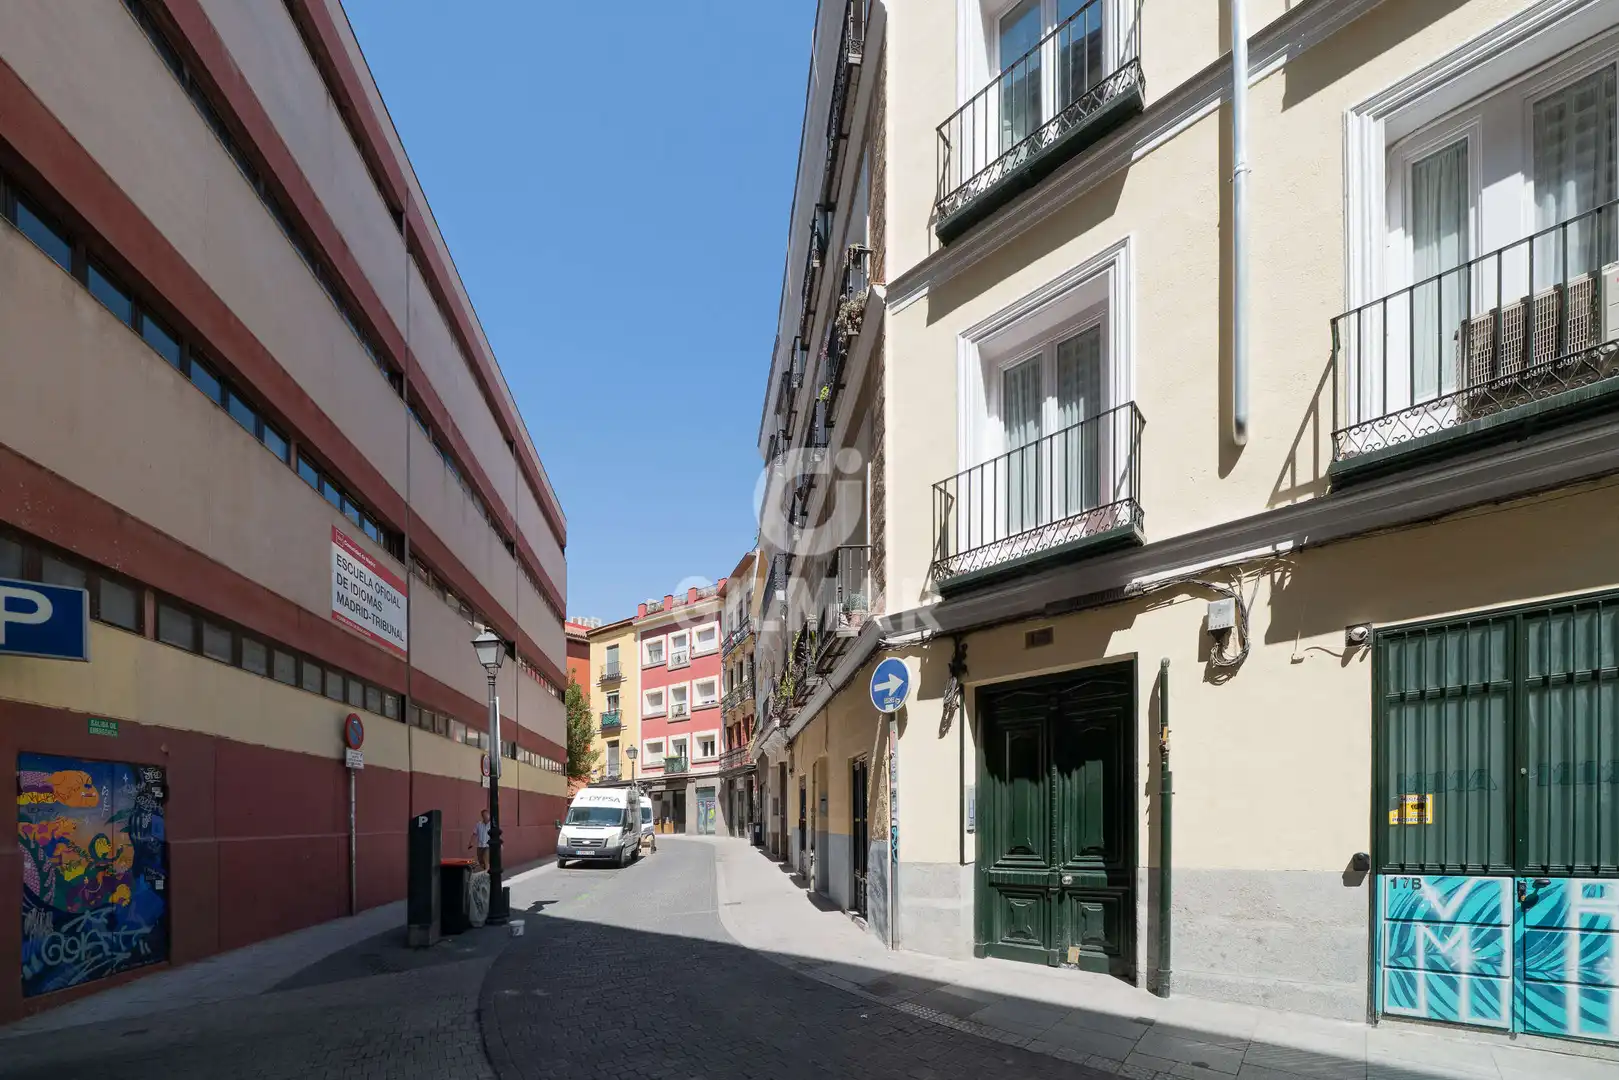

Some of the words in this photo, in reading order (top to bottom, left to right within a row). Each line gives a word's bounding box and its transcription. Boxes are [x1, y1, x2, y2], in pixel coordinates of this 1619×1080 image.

[336, 554, 373, 588] ESCUELA
[375, 582, 401, 609] OFICIAL
[336, 571, 348, 590] DE
[350, 581, 383, 612] IDIOMAS
[0, 585, 53, 645] P
[336, 591, 404, 642] MADRID-TRIBUNAL
[418, 816, 429, 828] P
[1389, 876, 1422, 891] 17B
